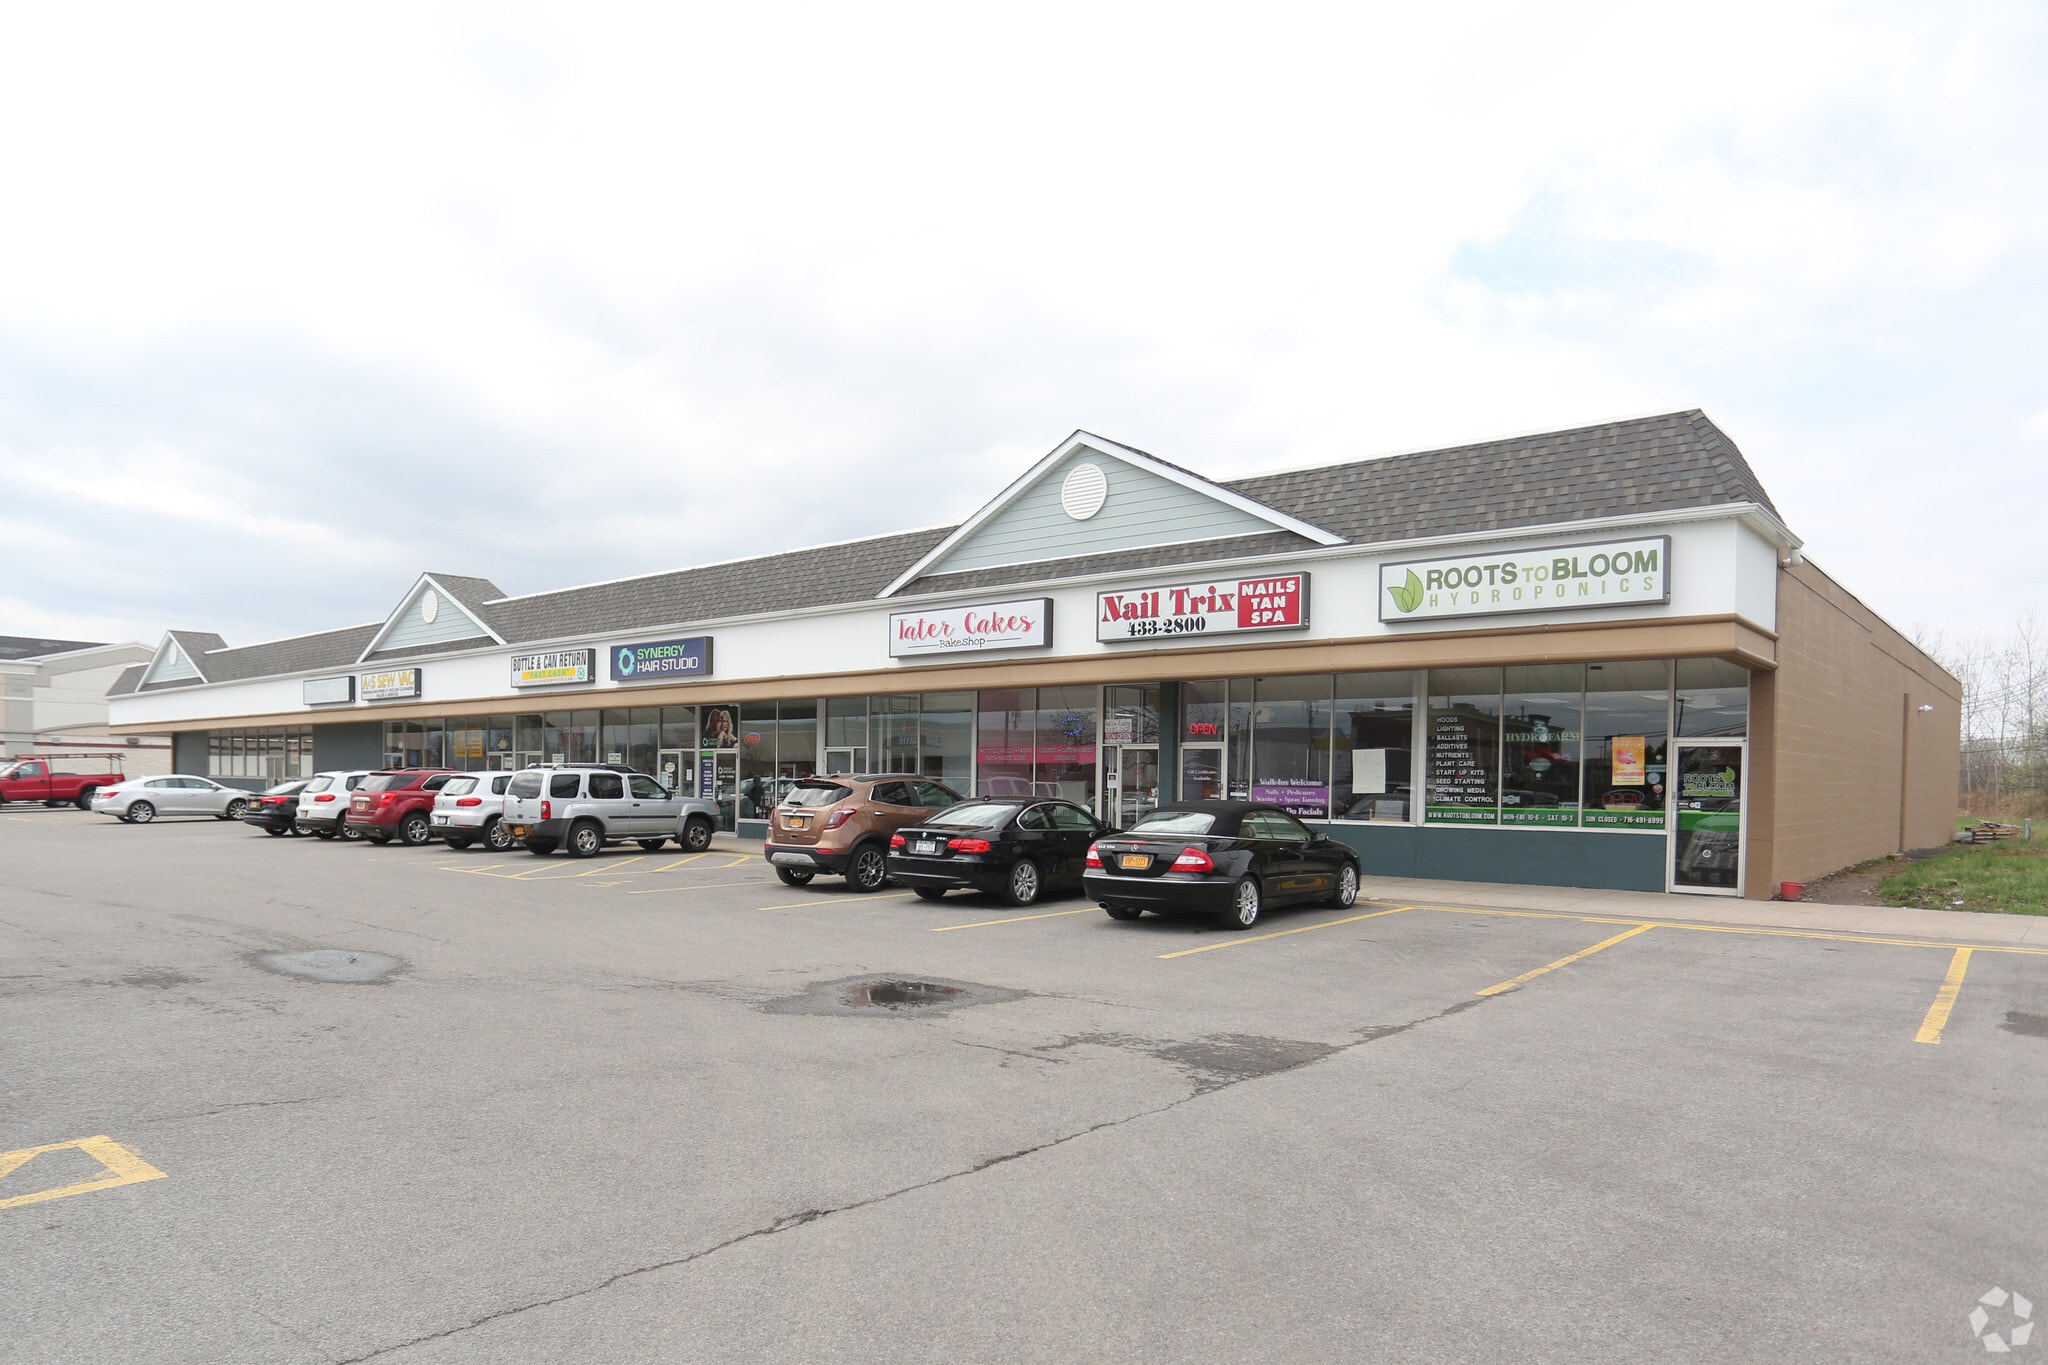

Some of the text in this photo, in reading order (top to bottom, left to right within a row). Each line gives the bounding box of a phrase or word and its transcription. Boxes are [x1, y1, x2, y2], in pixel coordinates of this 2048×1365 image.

[1426, 550, 1658, 591] ROOTS TO BLOOM
[1241, 580, 1296, 597] NAILS
[1429, 576, 1654, 608] HYDROPONICS
[1101, 585, 1236, 623] Nail Trix
[1250, 595, 1286, 610] TAN
[1250, 610, 1286, 624] SPA
[897, 611, 1037, 641] Tater Cakes
[1127, 616, 1206, 637] 433-2800
[637, 644, 685, 660] SYNERGY
[513, 651, 587, 672] BOTTLE & CAN RETURN
[637, 656, 698, 673] HAIR STUDIO
[397, 670, 415, 687] VAC
[1189, 723, 1217, 735] OPEN
[1259, 778, 1289, 786] Walk-Ins
[1683, 773, 1721, 783] ROOTS
[1696, 782, 1735, 791] BLOOM
[1602, 792, 1643, 805] OPEN
[1298, 807, 1324, 816] Facials
[1428, 812, 1495, 820] WWW.ROOTSTOBLOOM.COM
[1502, 813, 1525, 821] MON-FRI
[1547, 814, 1558, 822] SAT
[1561, 814, 1573, 822] 10-3
